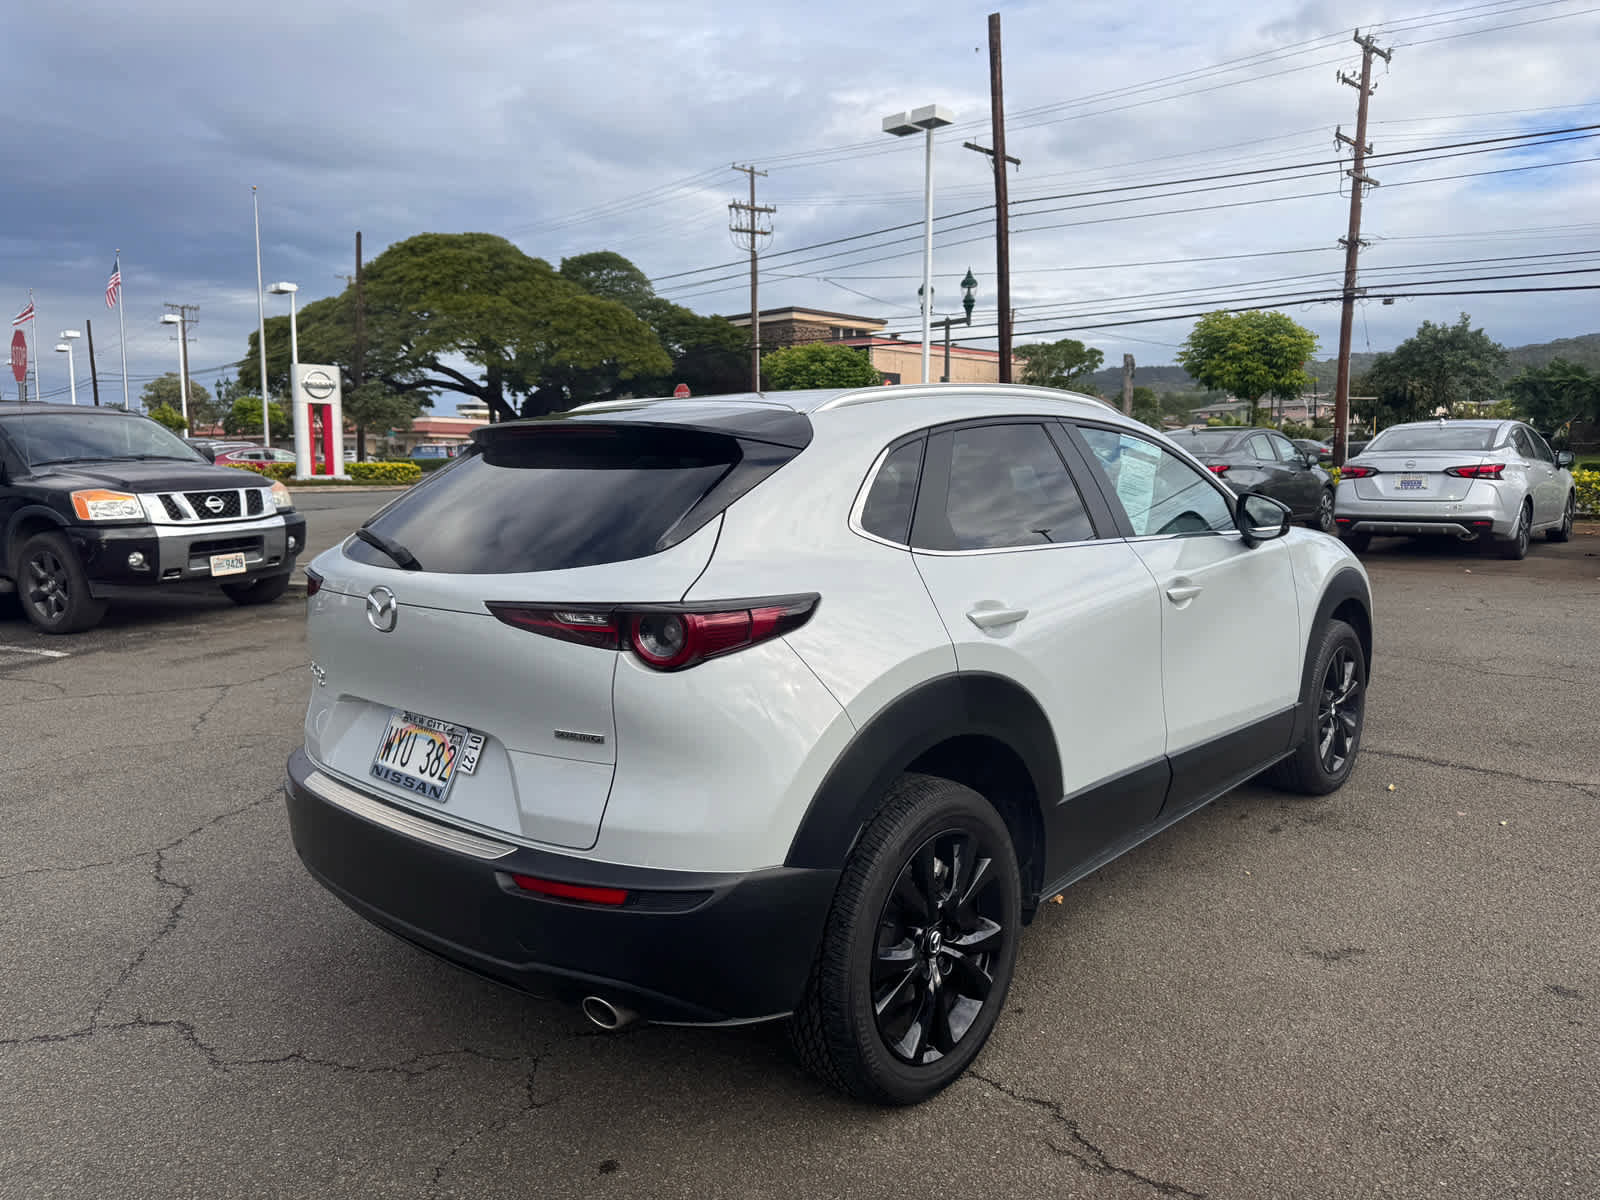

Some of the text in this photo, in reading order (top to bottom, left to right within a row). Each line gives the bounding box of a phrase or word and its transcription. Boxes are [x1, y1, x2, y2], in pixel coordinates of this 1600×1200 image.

[12, 345, 27, 367] STOP
[427, 719, 448, 732] CITY
[381, 726, 457, 782] WYU 382
[462, 735, 482, 772] 01 27
[371, 764, 443, 799] NISSAN
